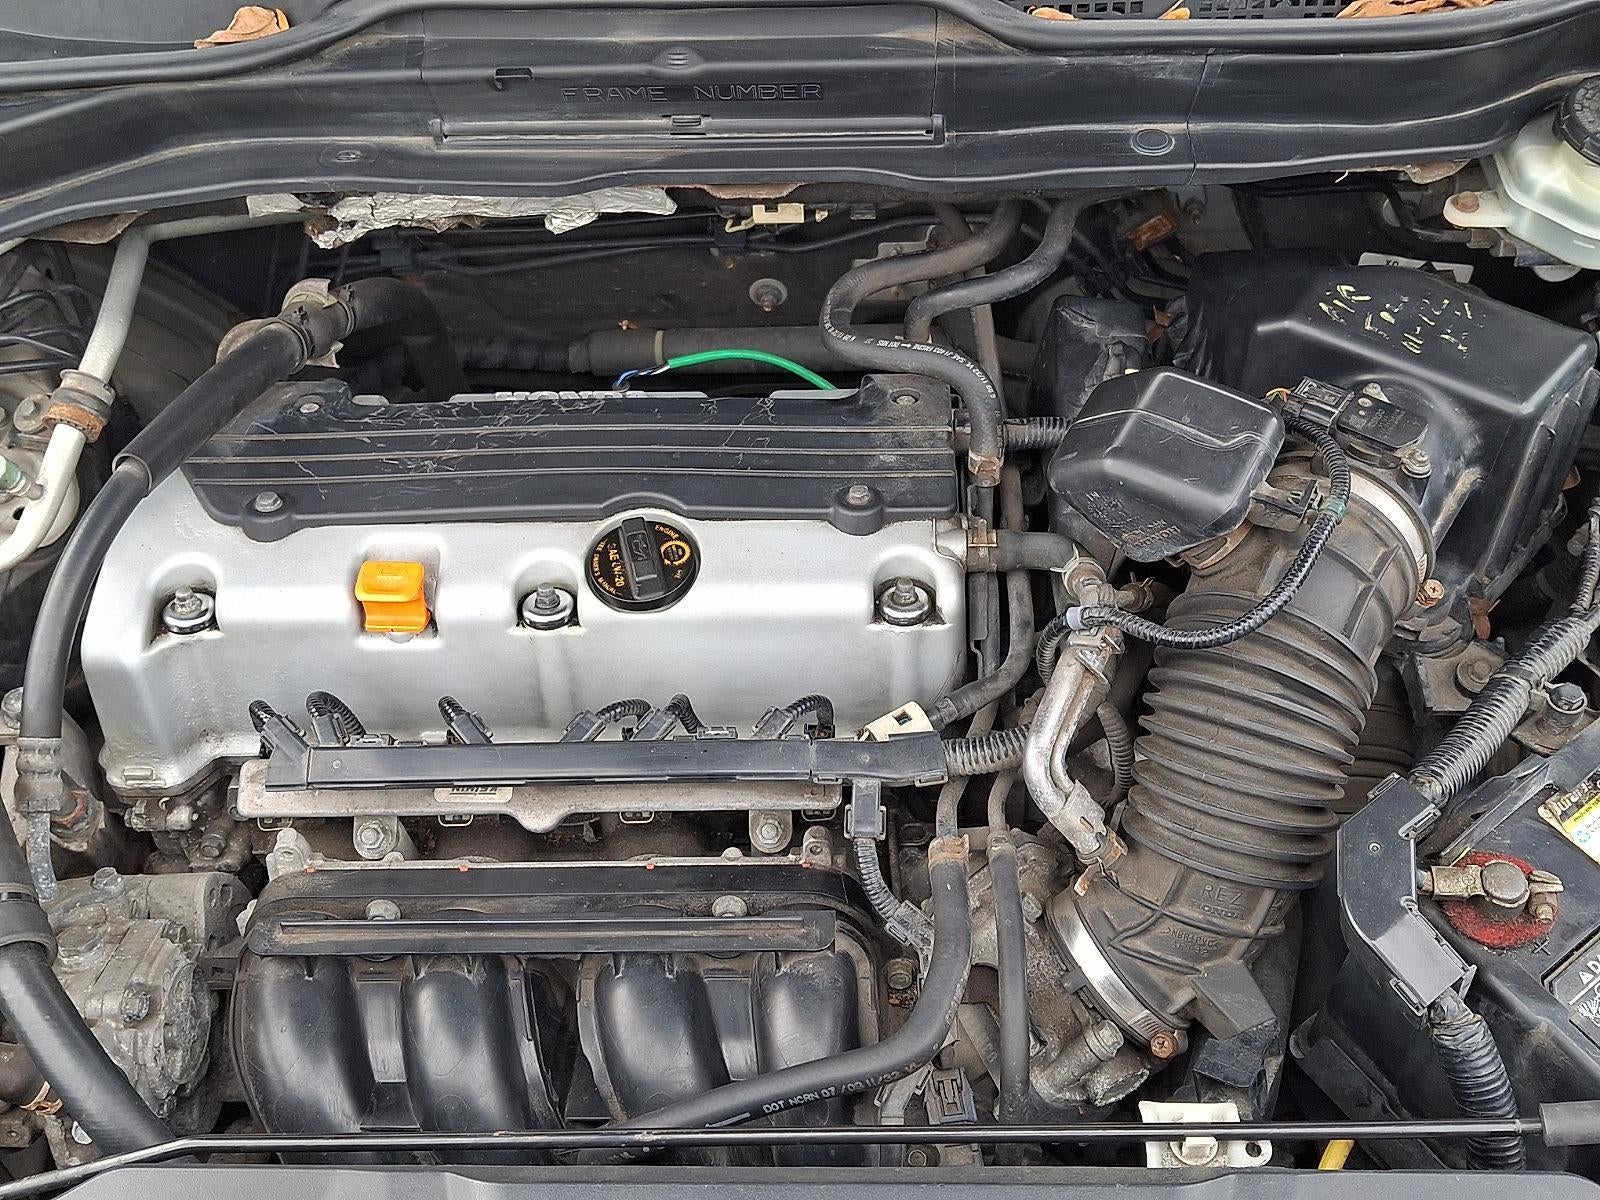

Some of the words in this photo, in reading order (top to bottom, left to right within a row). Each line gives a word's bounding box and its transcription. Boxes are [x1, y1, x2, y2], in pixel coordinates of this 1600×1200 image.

[561, 86, 667, 102] FRAME
[693, 83, 824, 101] NUMBER
[654, 524, 680, 539] ENGINE
[1201, 884, 1244, 906] REZ
[763, 1101, 785, 1114] DOT
[789, 1090, 820, 1106] NCRN
[820, 1086, 836, 1098] 07
